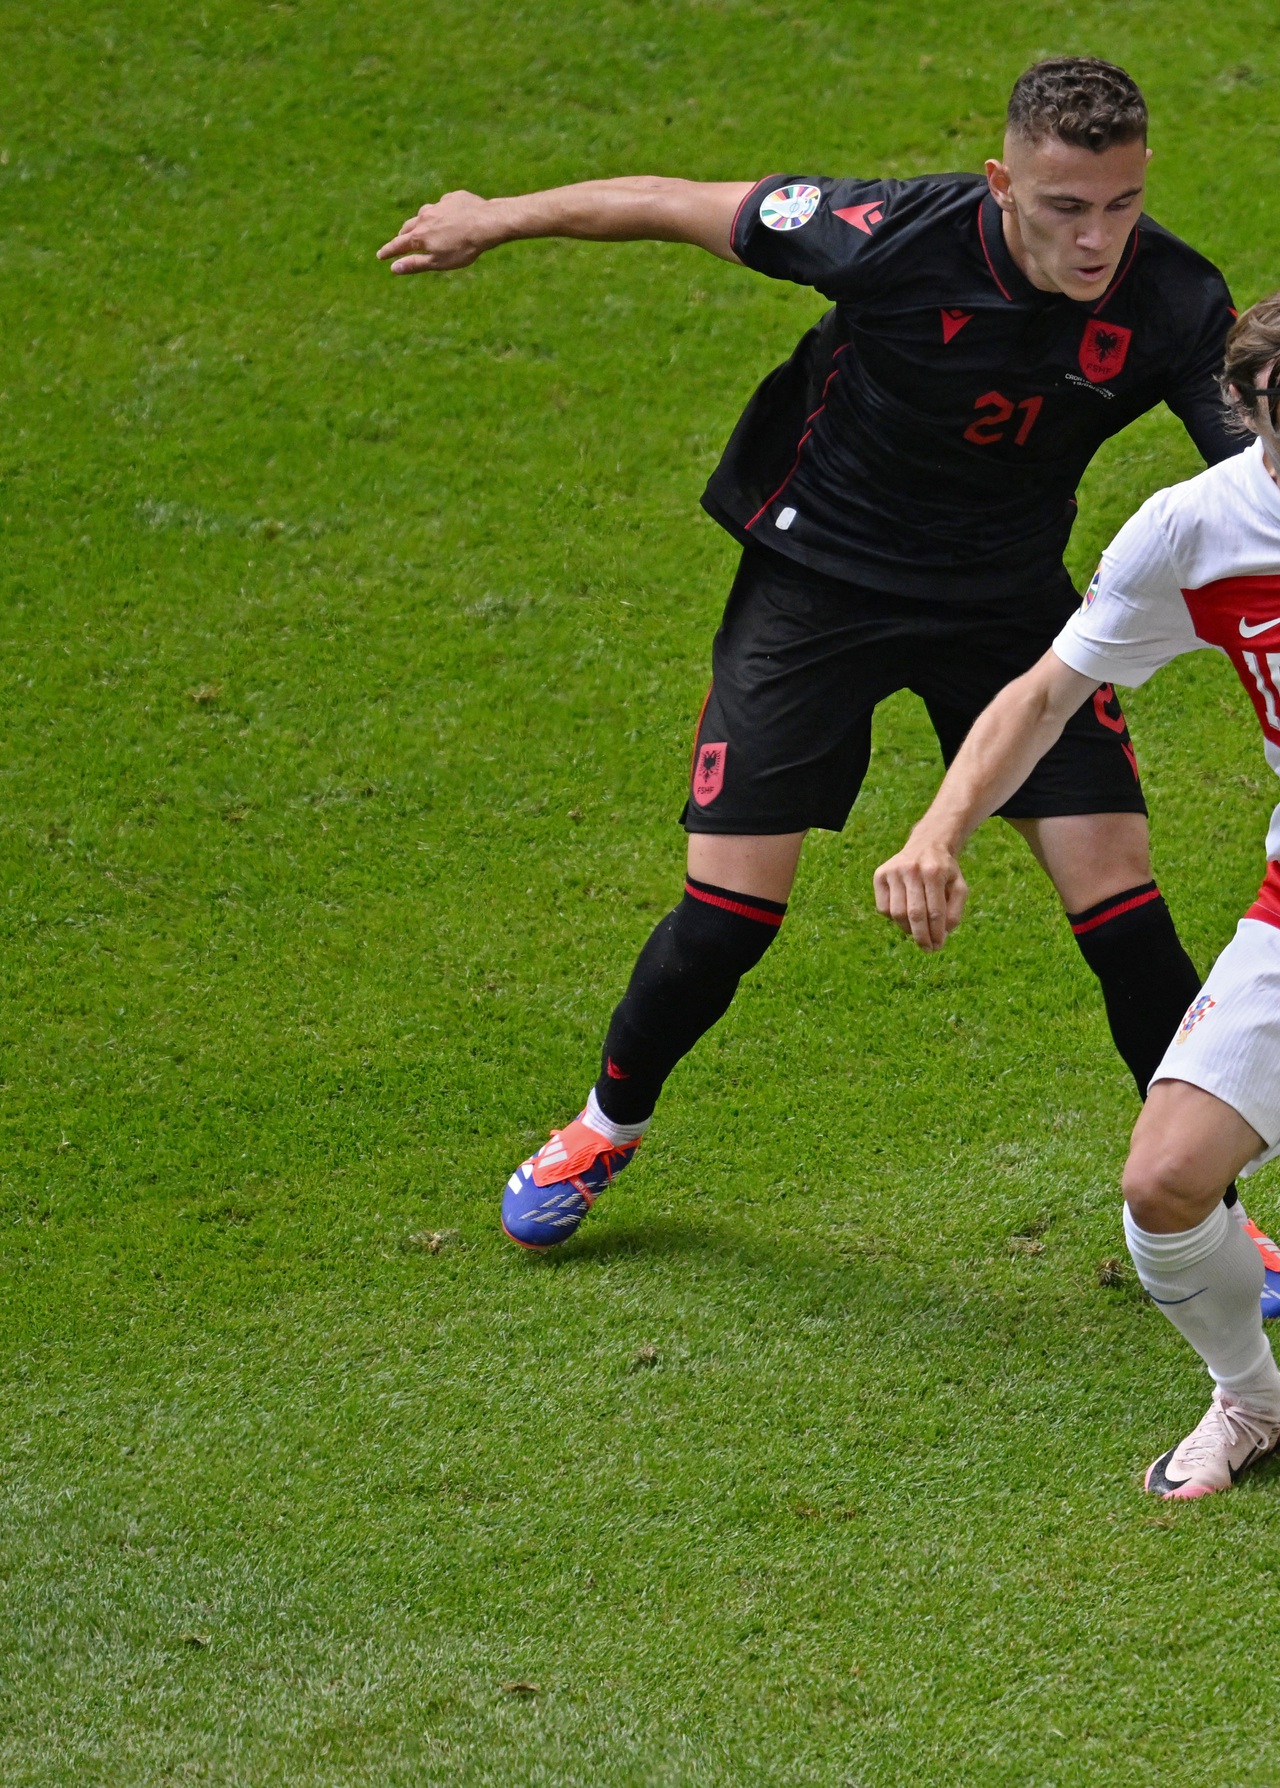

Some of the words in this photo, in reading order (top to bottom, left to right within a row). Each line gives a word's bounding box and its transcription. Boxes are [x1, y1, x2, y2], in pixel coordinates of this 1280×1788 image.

[1086, 362, 1113, 375] FSHF
[964, 391, 1043, 446] 21
[697, 786, 714, 795] FSHF
